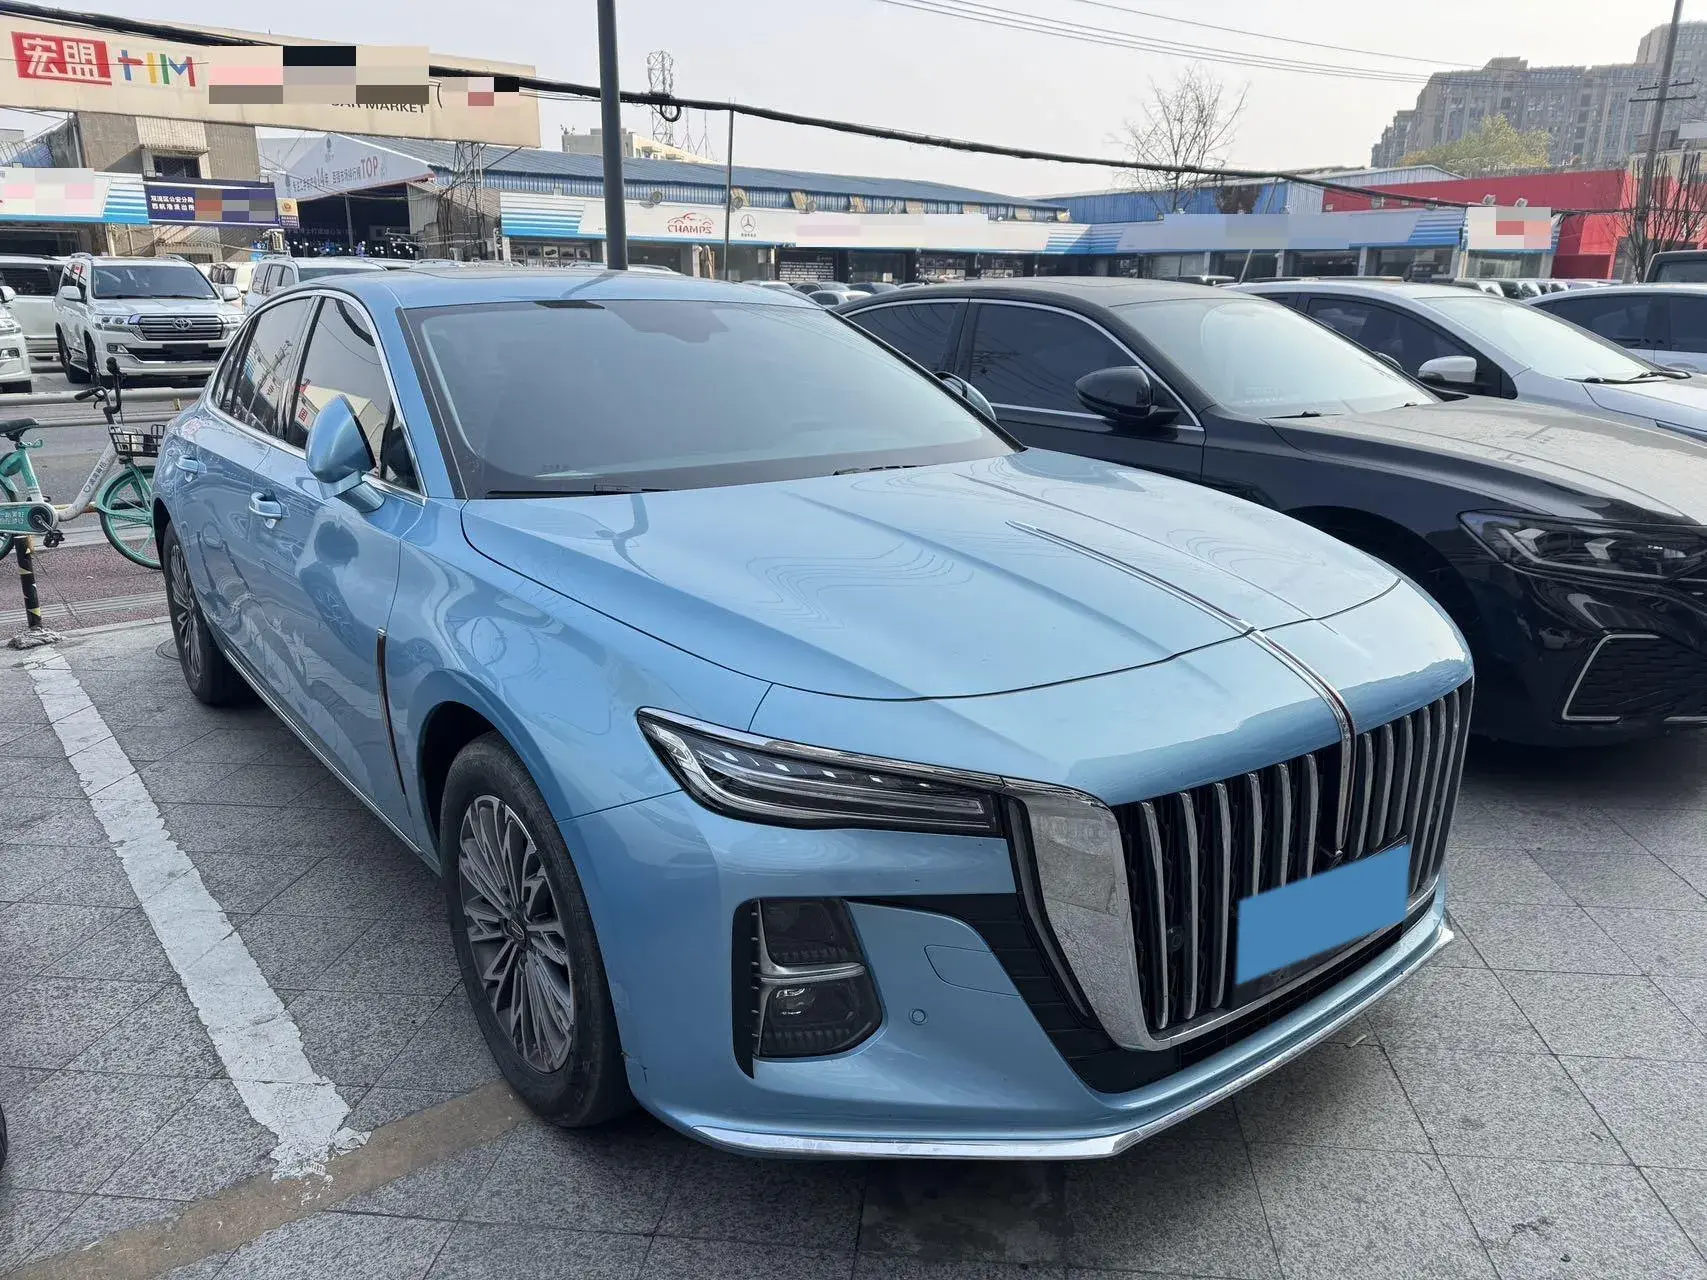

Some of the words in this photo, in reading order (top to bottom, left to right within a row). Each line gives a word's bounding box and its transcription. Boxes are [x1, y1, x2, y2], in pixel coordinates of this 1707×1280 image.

[21, 37, 108, 82] 宏盟
[360, 155, 378, 179] TOP
[667, 224, 712, 234] CHAMPS
